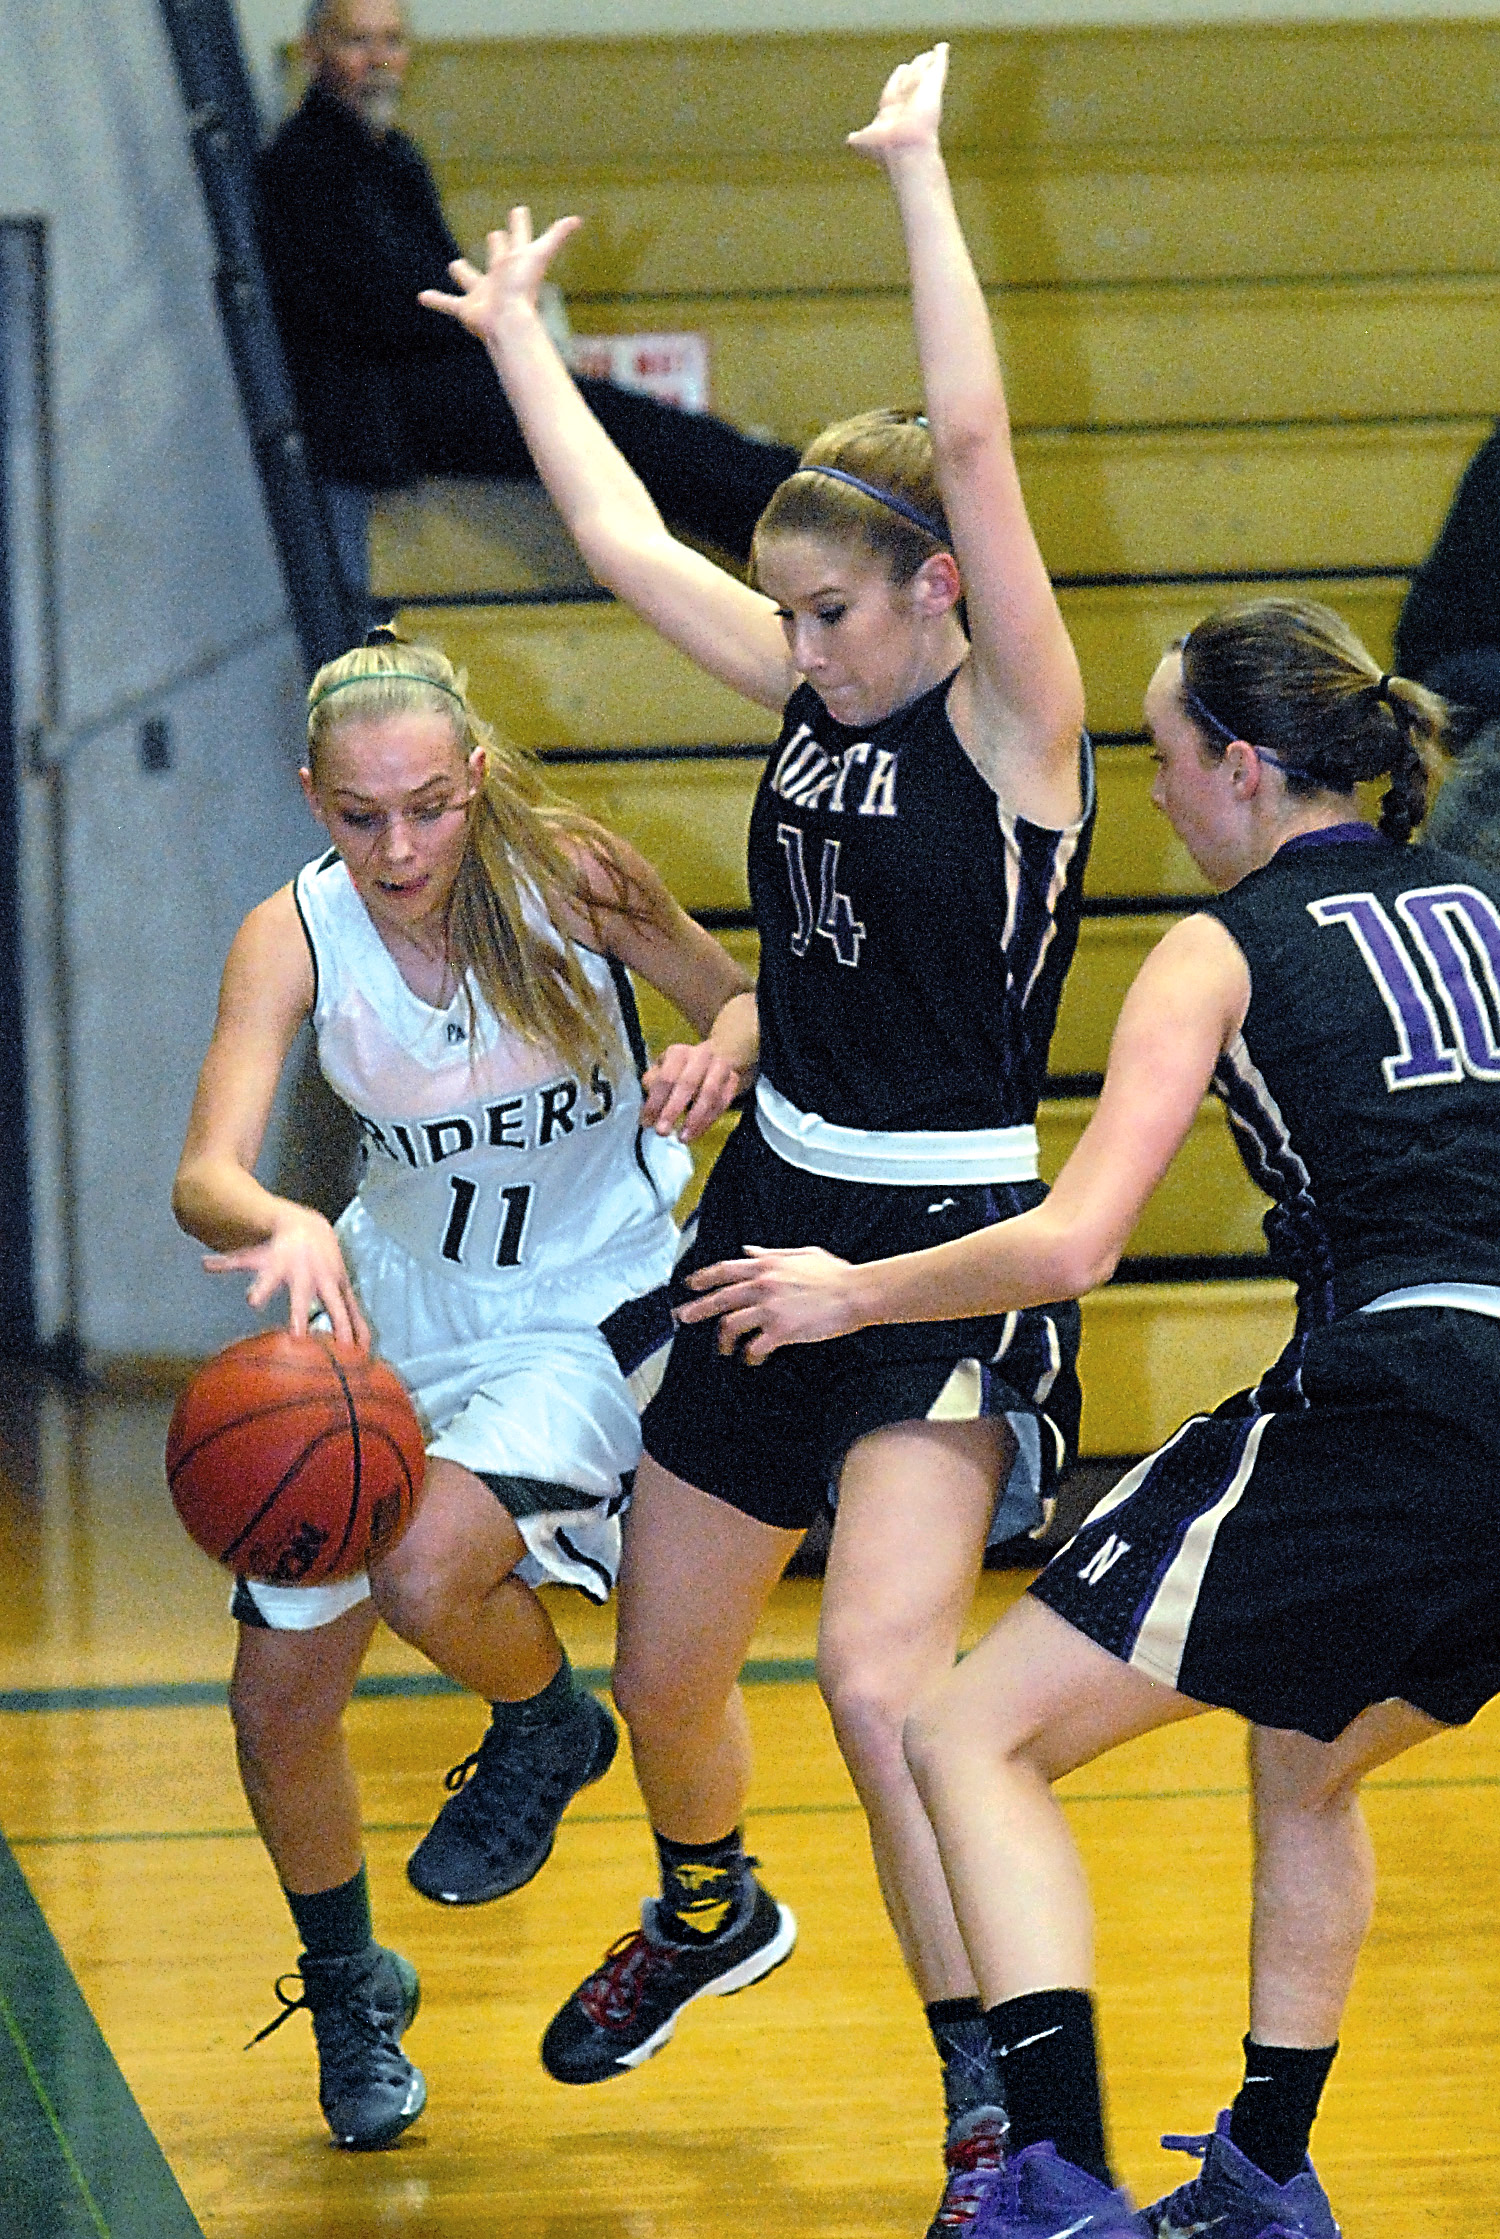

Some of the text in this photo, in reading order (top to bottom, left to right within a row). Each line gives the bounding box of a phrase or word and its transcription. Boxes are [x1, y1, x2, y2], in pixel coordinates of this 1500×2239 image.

[776, 822, 866, 967] 14
[1306, 884, 1500, 1092] 10
[441, 1175, 532, 1268] 11
[1077, 1533, 1132, 1586] N
